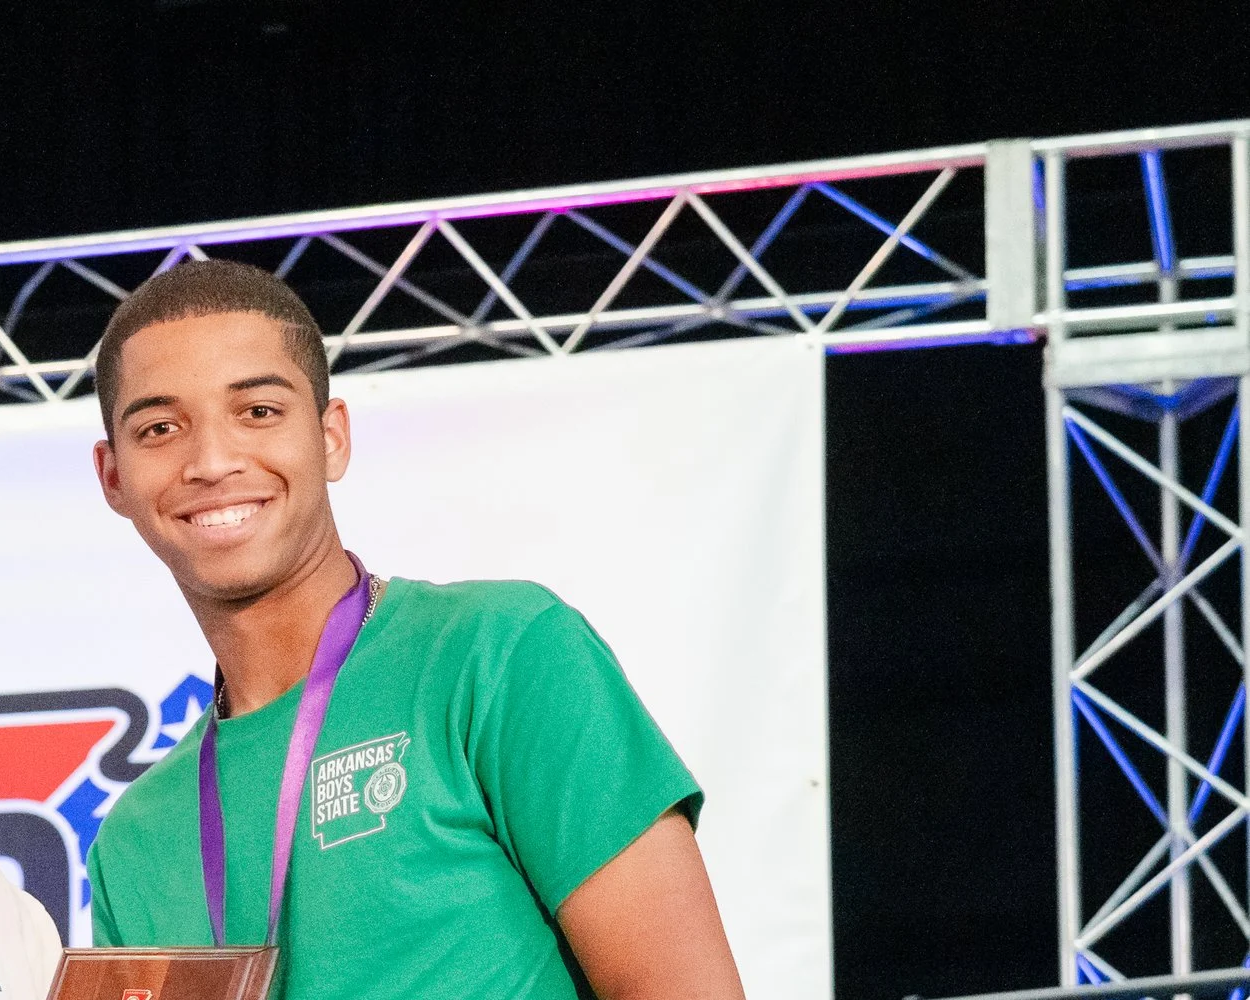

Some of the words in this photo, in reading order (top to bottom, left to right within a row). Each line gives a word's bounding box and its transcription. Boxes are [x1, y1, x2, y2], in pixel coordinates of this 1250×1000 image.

[317, 743, 394, 783] ARKANSAS
[317, 774, 353, 804] BOYS
[317, 792, 360, 824] STATE
